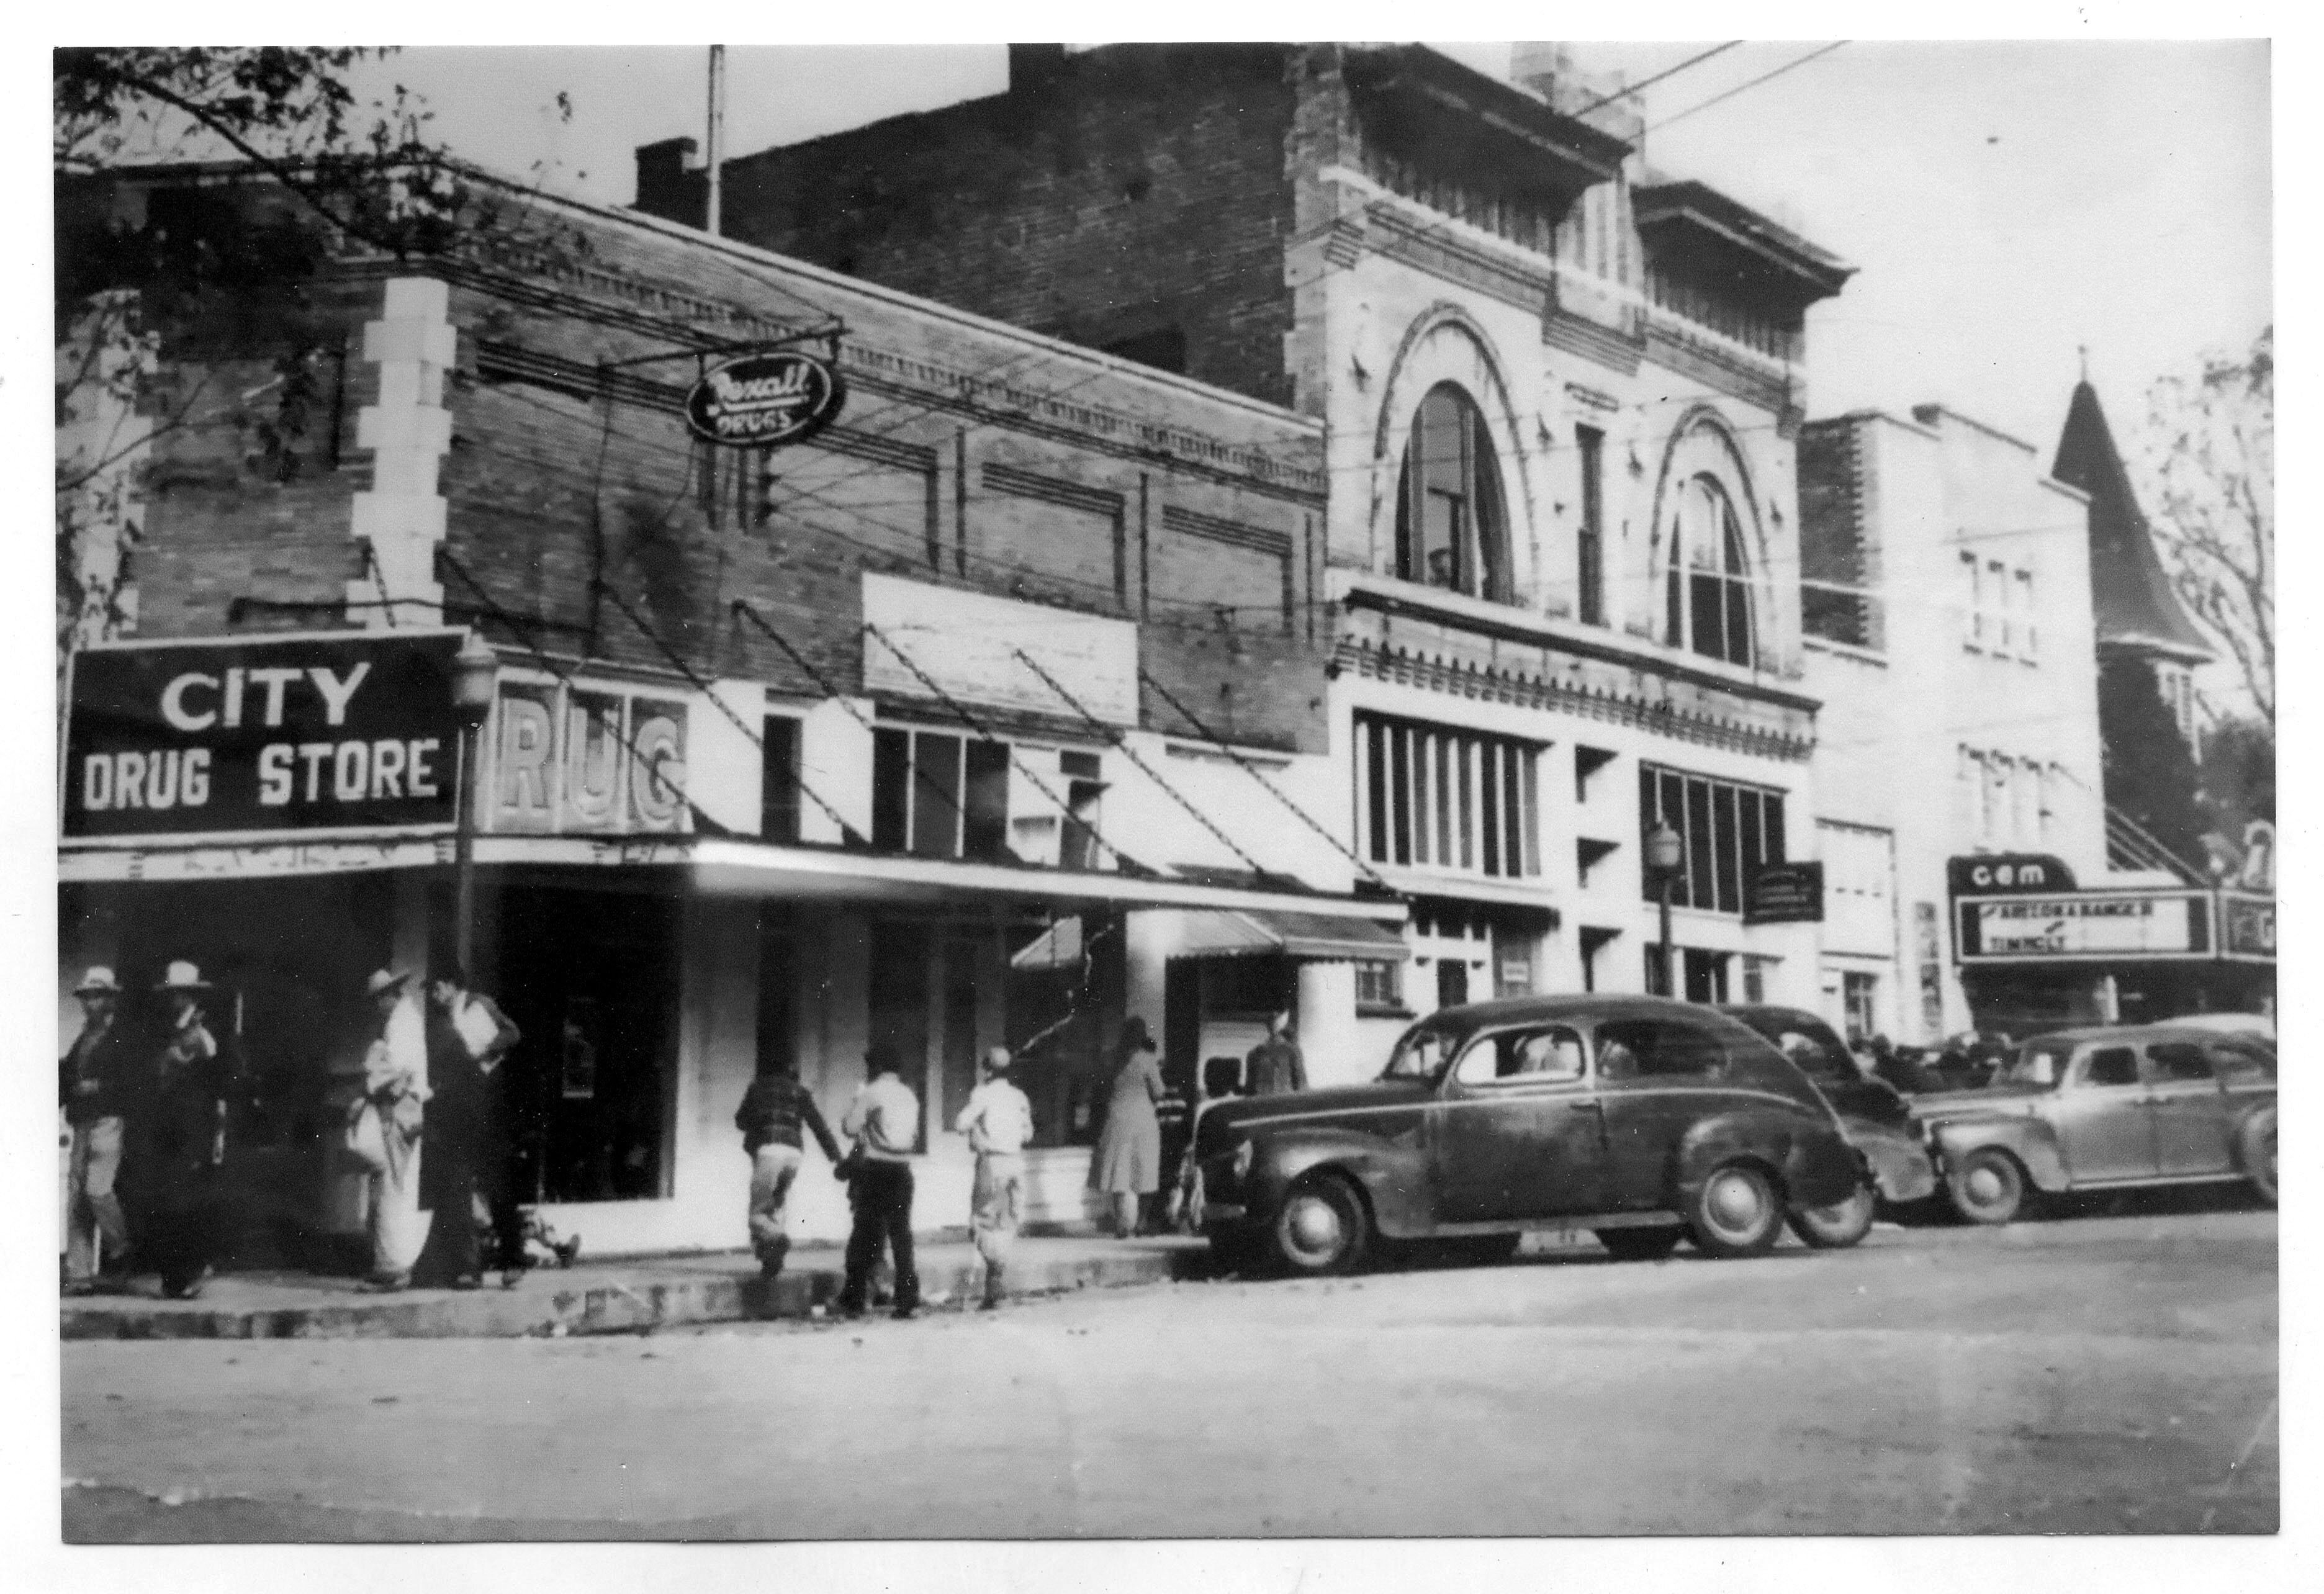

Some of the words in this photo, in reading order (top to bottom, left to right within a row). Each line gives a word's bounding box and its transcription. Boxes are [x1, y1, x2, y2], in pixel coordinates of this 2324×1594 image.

[160, 662, 371, 731] CITY
[83, 748, 211, 811] DRUG
[258, 739, 441, 805] STORE
